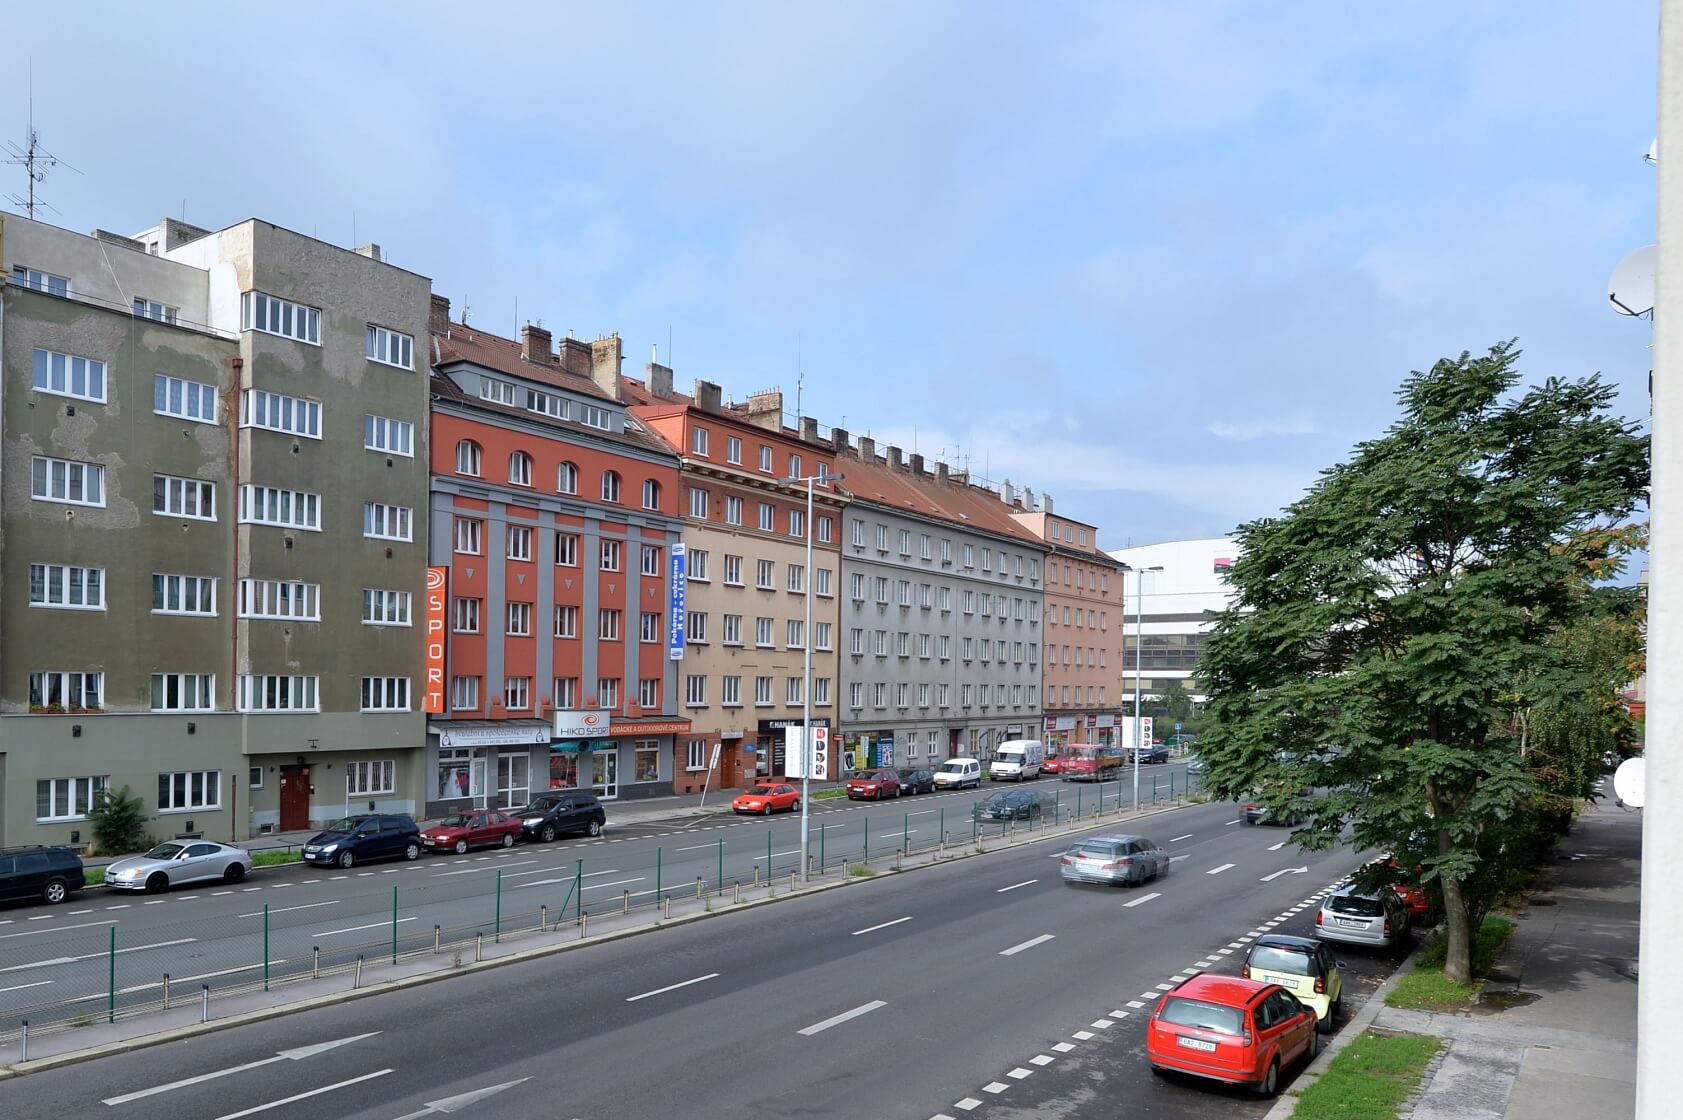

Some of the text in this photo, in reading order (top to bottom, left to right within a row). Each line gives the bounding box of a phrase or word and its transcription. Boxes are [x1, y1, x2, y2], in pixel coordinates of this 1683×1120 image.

[428, 595, 442, 708] SPORT
[560, 726, 609, 736] HIKO SPORT
